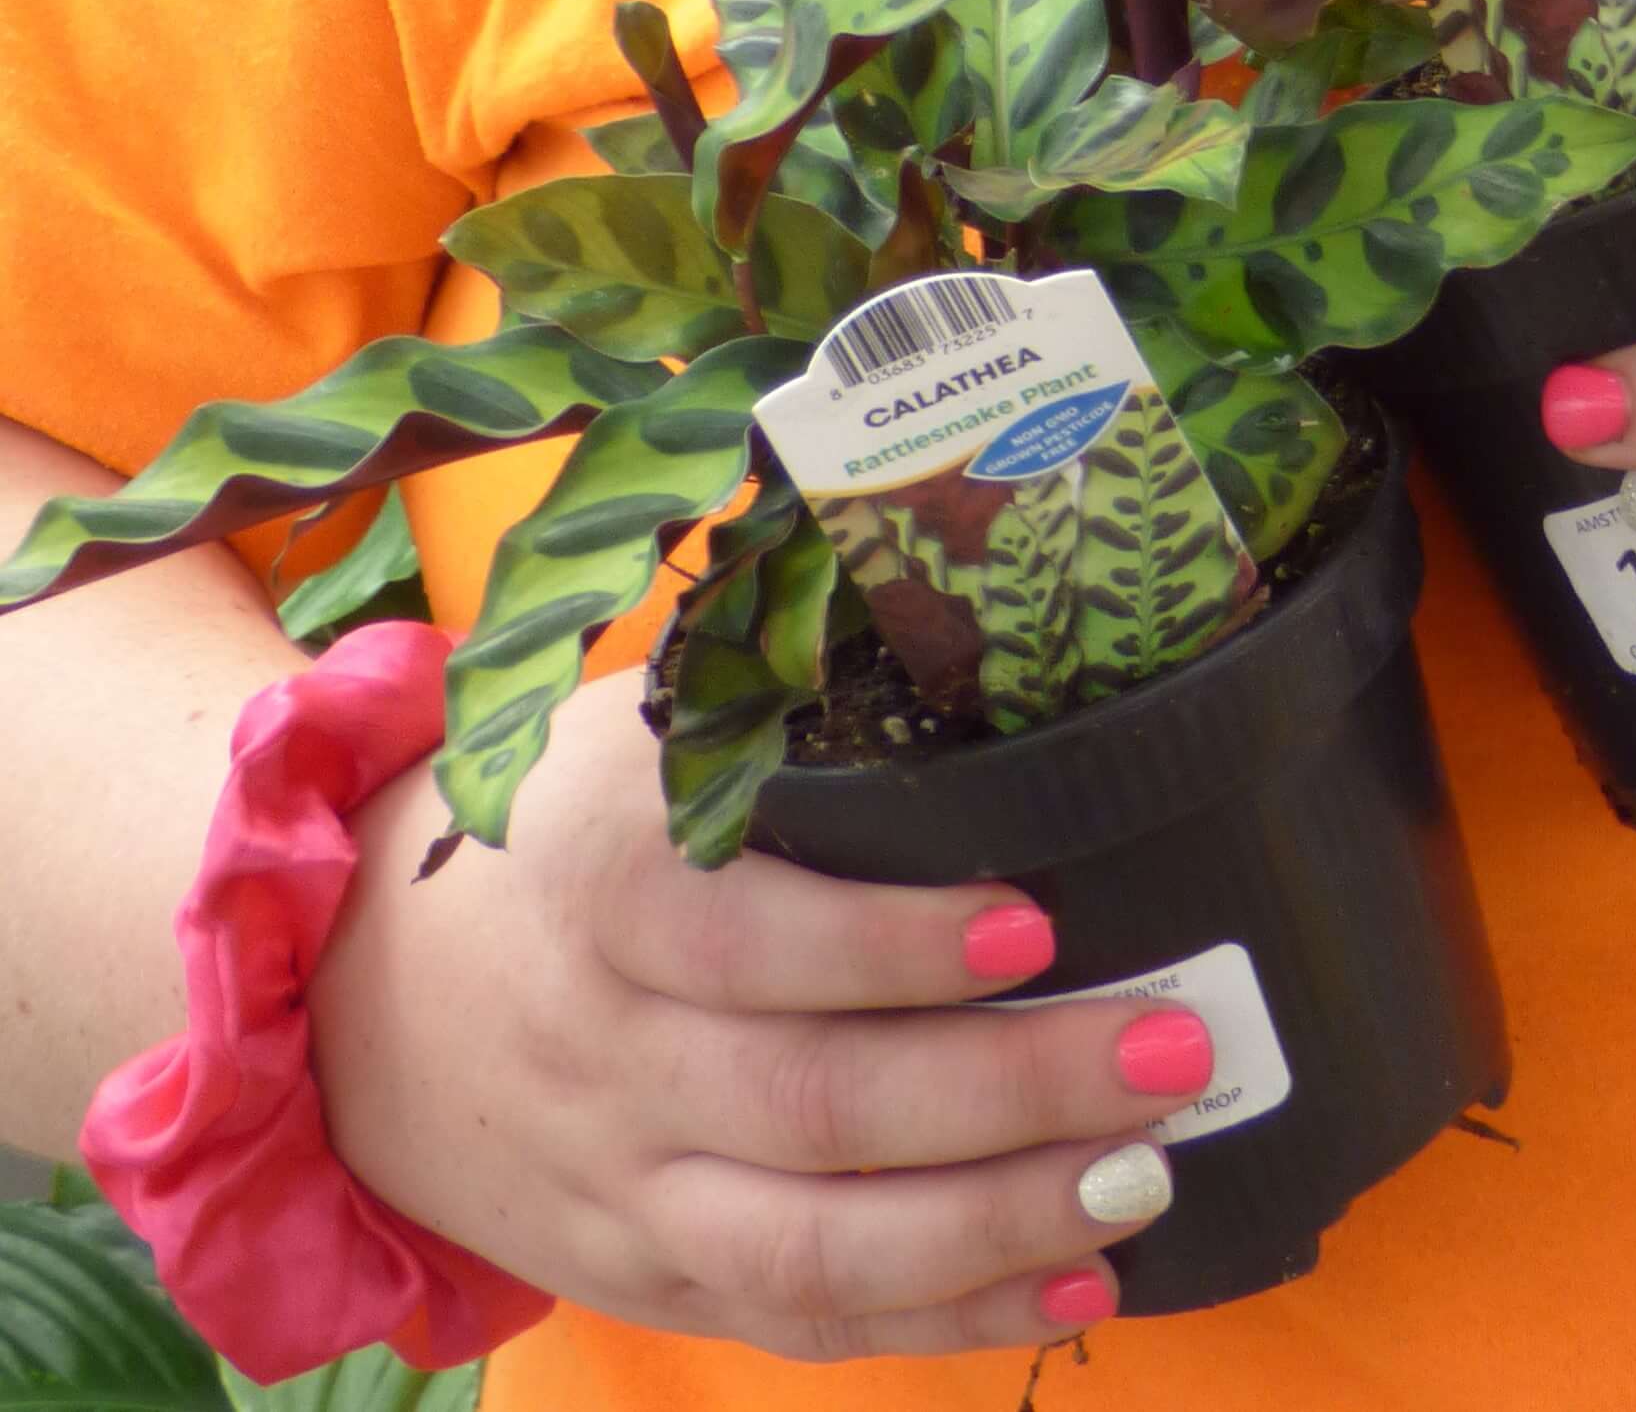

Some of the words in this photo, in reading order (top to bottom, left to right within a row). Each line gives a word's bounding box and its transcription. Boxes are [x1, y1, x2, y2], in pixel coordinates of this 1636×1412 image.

[830, 388, 843, 401] 8
[867, 353, 927, 385] 03683
[940, 324, 998, 355] 73225
[863, 347, 1043, 428] CALATHEA
[843, 399, 1015, 478] Rattlesnake
[1019, 363, 1098, 406] Plant
[985, 442, 1045, 475] GROWN
[1043, 400, 1114, 447] PESTICIDE
[1010, 424, 1044, 447] NON
[1045, 406, 1079, 429] GMO
[1040, 437, 1078, 462] FREE
[1575, 507, 1621, 534] AMST
